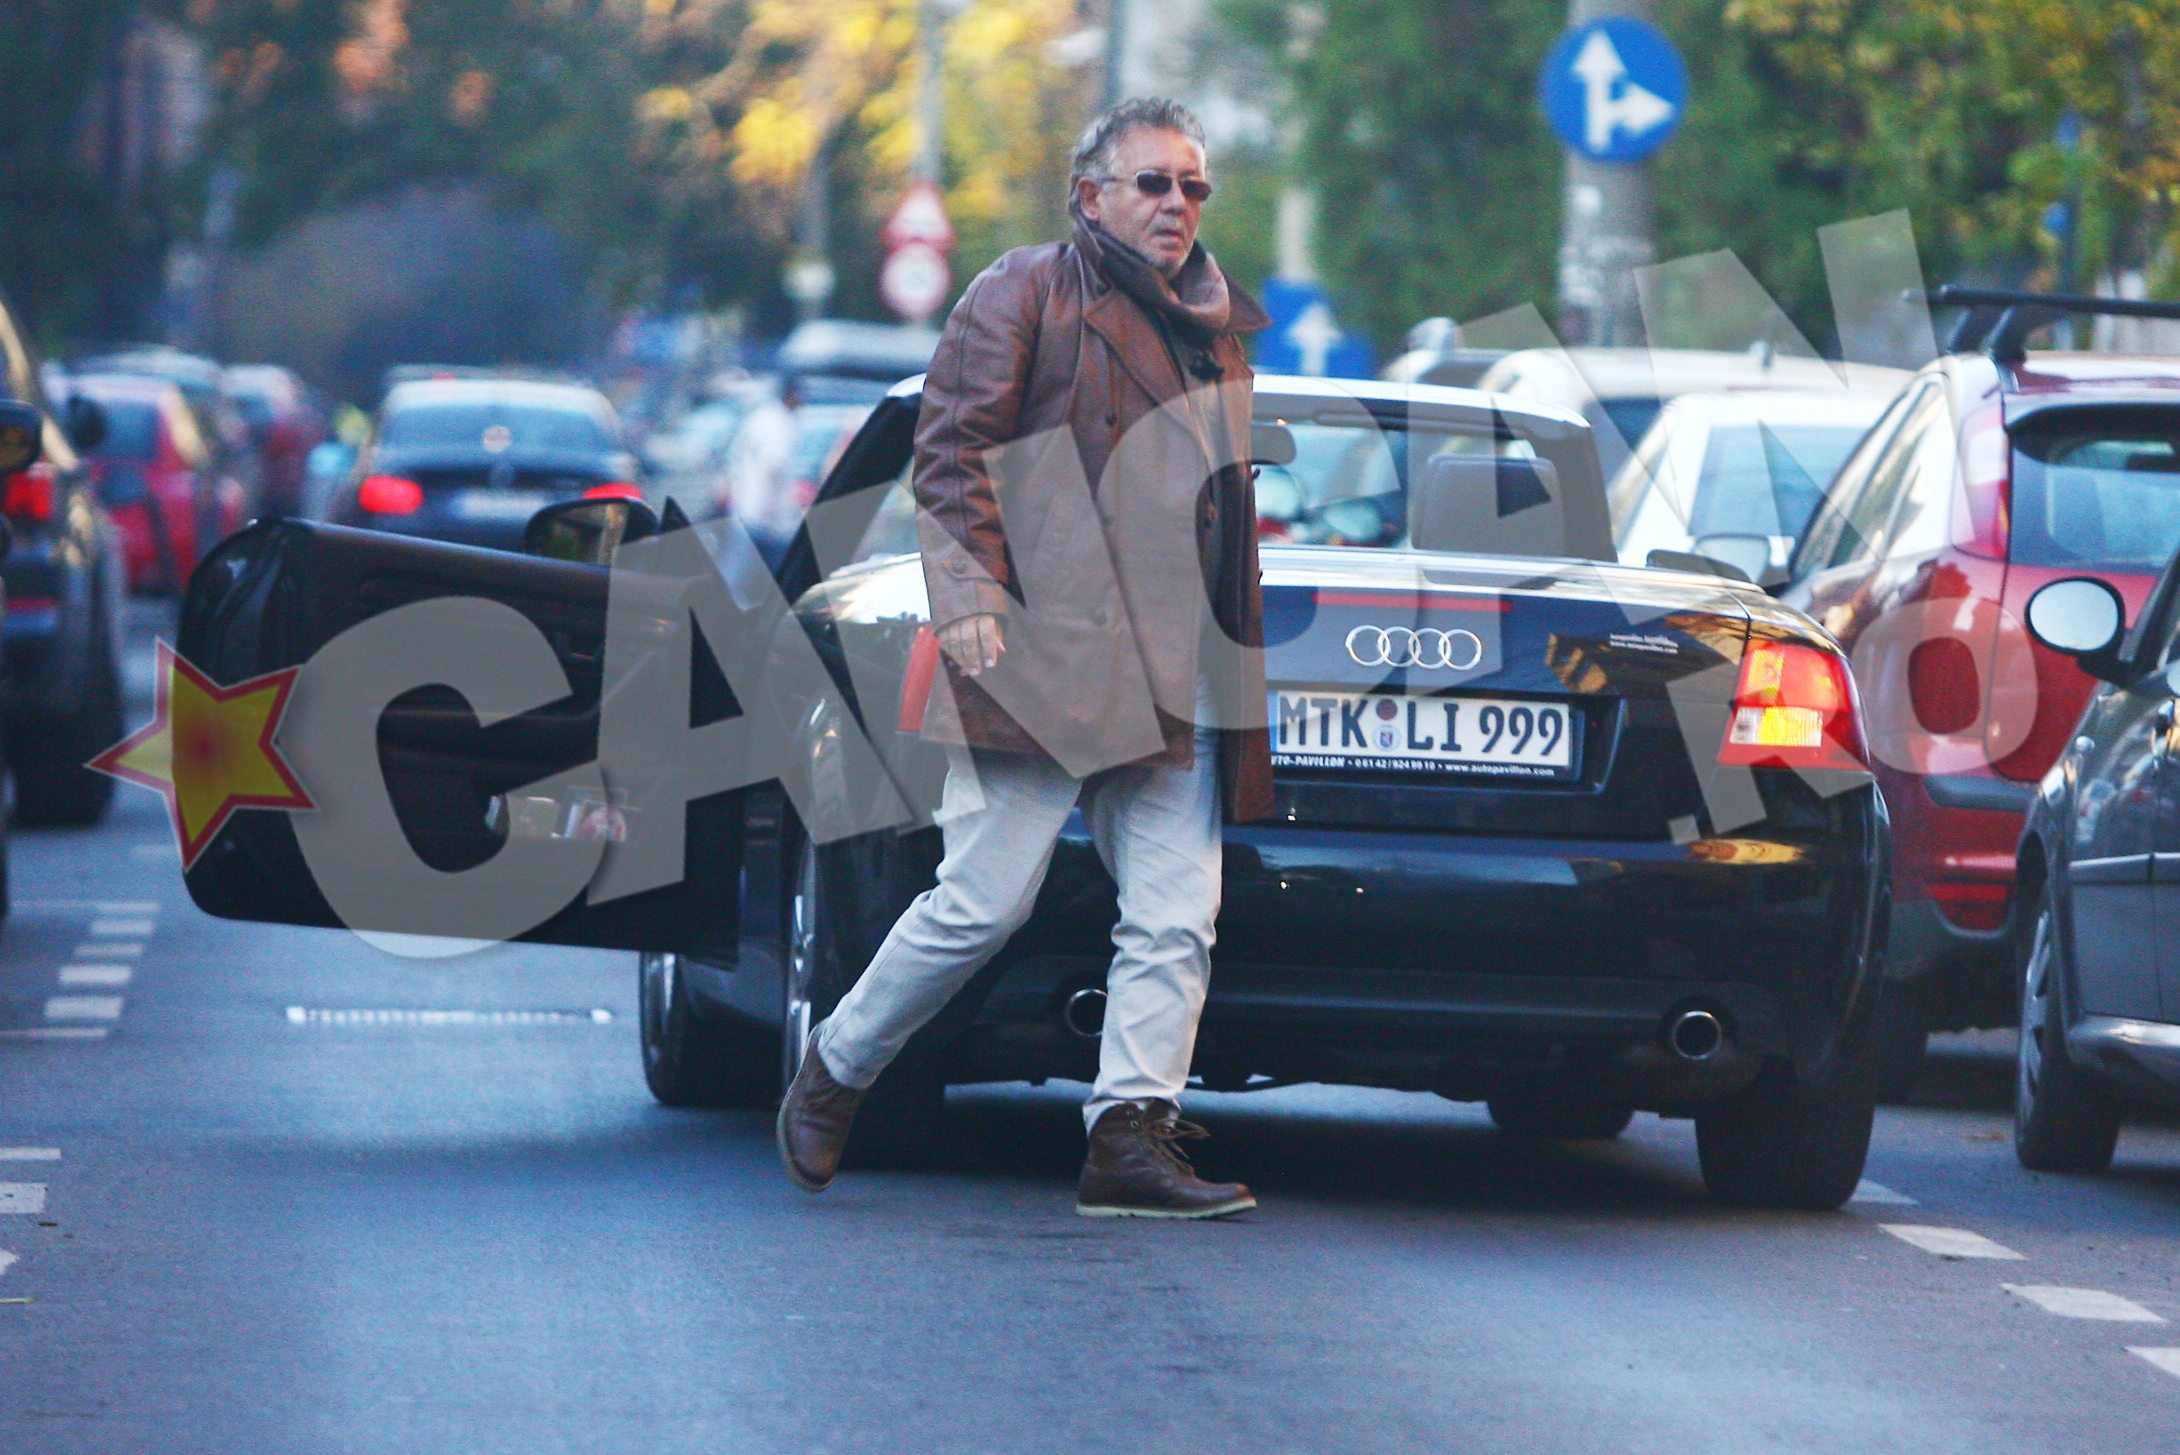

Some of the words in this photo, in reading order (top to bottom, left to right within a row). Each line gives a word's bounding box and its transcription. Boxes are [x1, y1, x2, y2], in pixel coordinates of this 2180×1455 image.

[1279, 696, 1368, 748] MTK
[1407, 701, 1462, 752] LI
[1479, 706, 1563, 756] 999
[1270, 755, 1346, 768] UTO-PAVILLON
